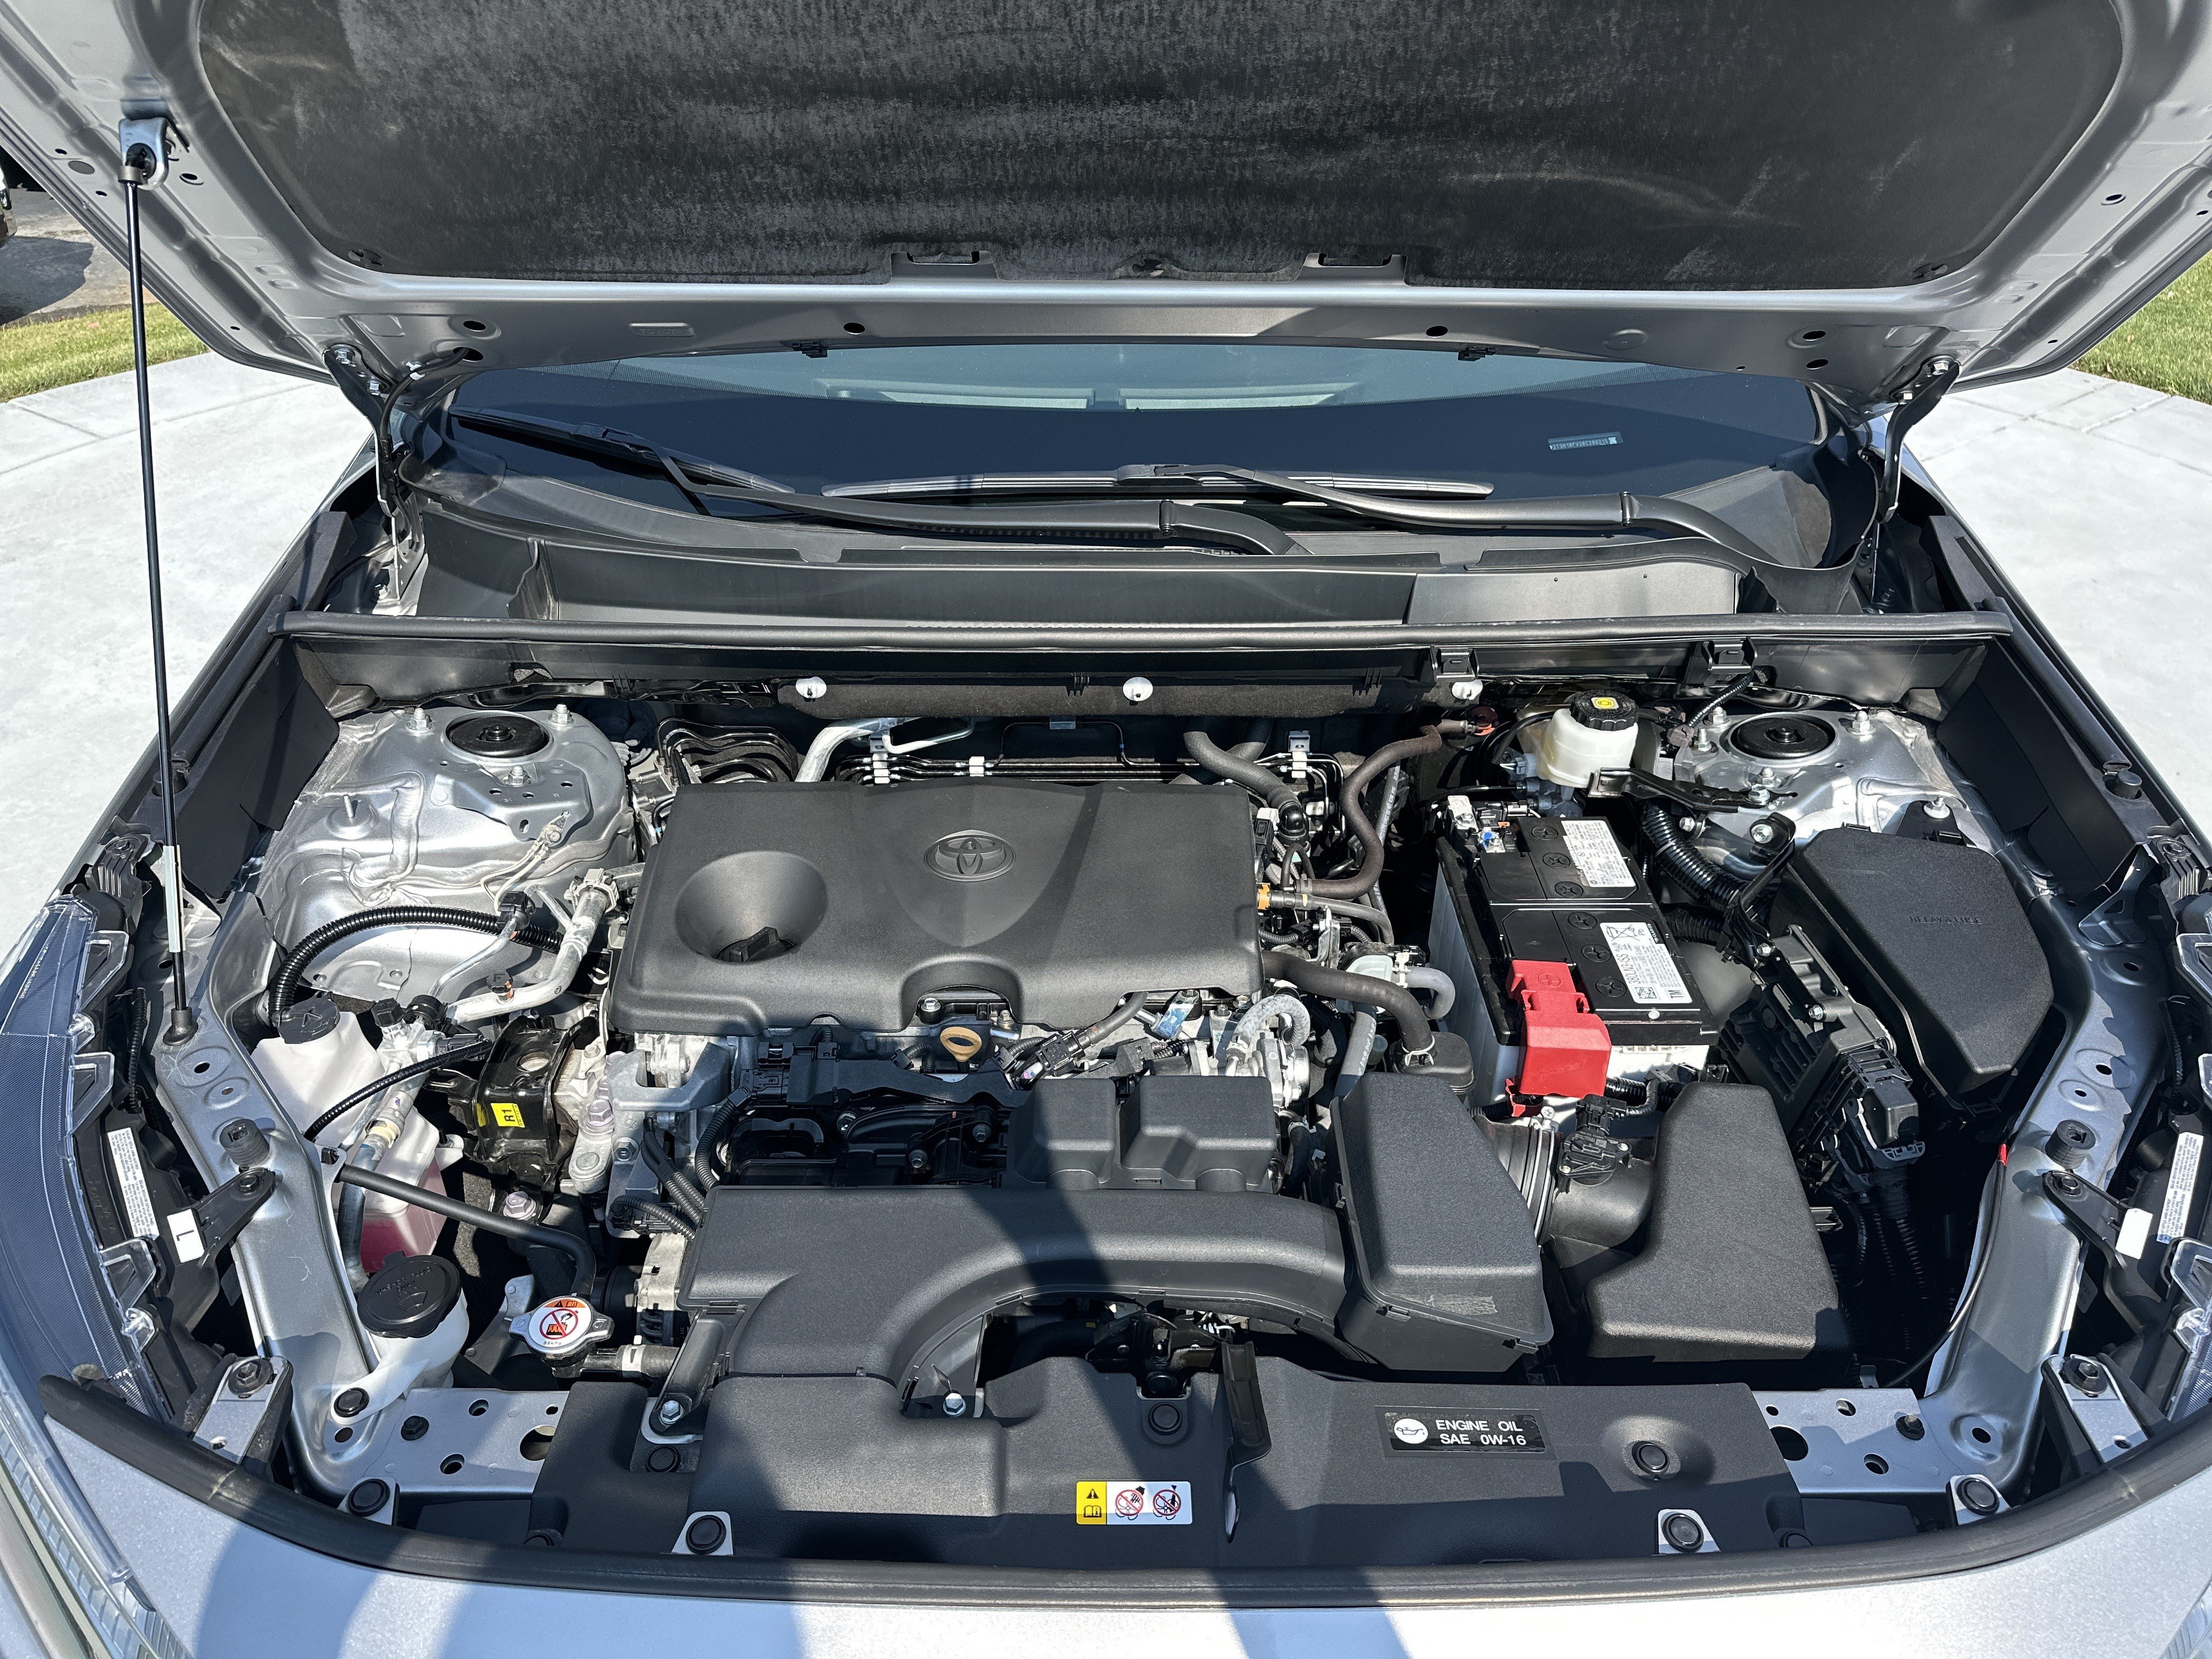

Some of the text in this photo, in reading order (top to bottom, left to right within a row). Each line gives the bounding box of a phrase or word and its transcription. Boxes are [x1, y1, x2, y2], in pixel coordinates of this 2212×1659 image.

[1667, 990, 1684, 999] TM
[501, 1109, 516, 1122] R1
[375, 1266, 432, 1296] WASHER FLUID
[1435, 1419, 1523, 1432] ENGINE OIL
[1440, 1433, 1527, 1446] SAE 0W-16
